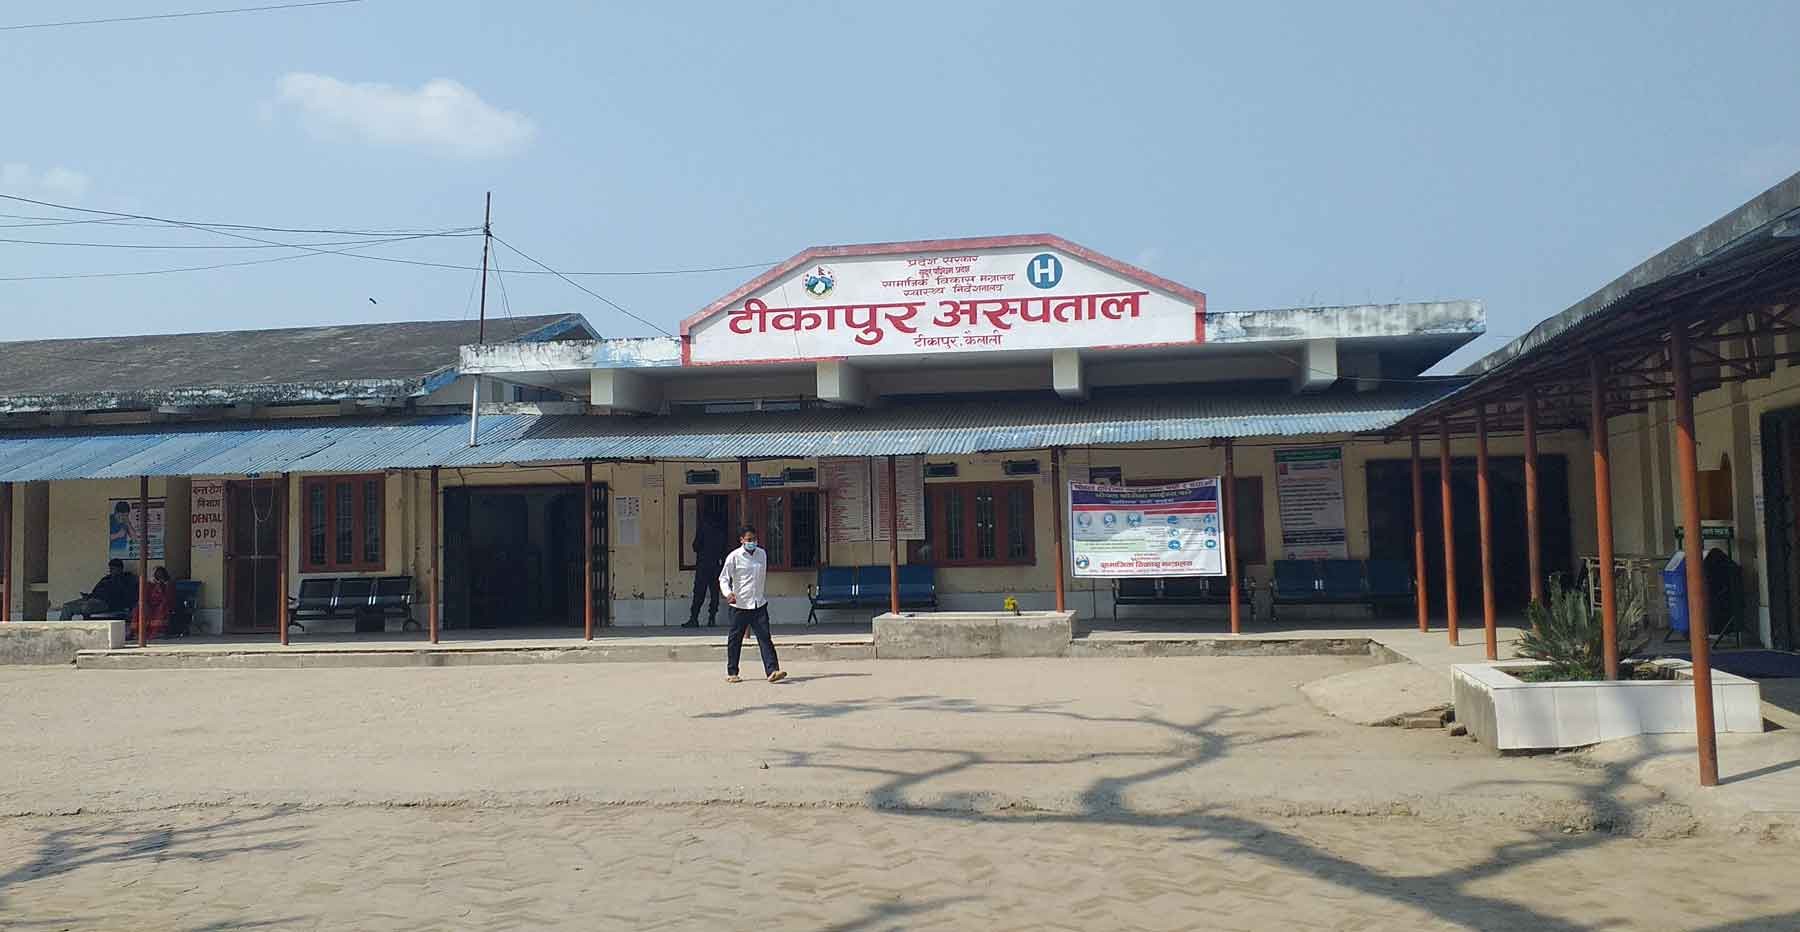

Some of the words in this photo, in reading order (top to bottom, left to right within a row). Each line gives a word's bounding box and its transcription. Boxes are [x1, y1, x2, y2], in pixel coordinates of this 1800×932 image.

[907, 256, 936, 267] प्रदेश
[943, 255, 979, 264] सरकार
[1034, 259, 1055, 283] H
[882, 277, 928, 288] सामाजिक
[935, 275, 976, 286] विकास
[728, 298, 926, 346] टीकापुर
[933, 290, 1150, 330] अस्पताल
[192, 513, 223, 525] DENTAL
